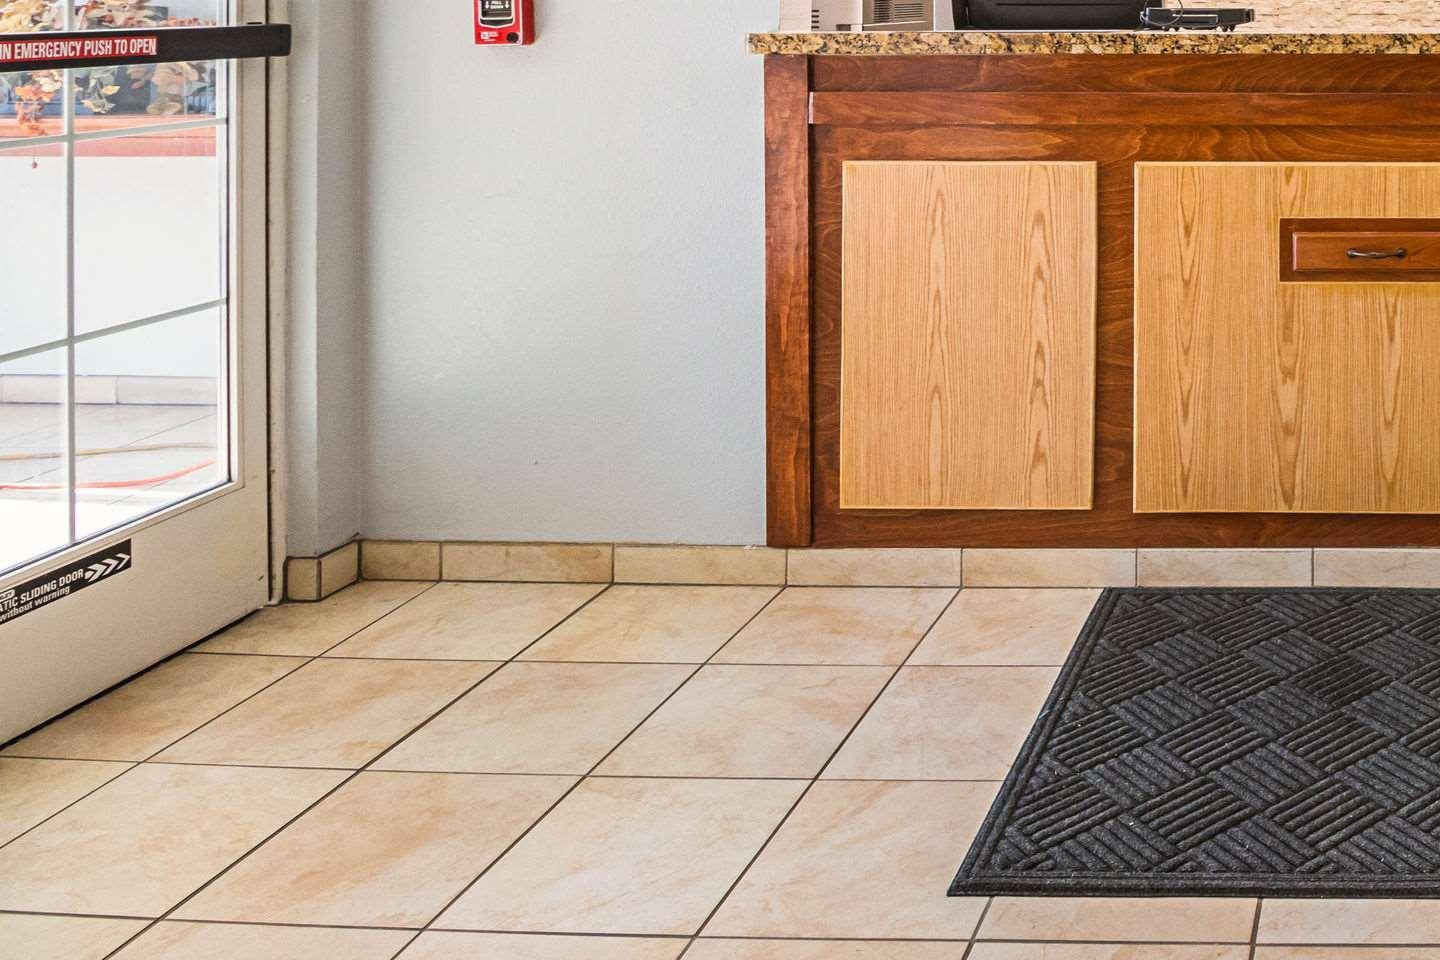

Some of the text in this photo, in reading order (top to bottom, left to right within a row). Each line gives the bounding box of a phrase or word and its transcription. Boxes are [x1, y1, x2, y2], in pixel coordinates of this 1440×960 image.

[14, 41, 82, 59] EMERGENCY
[84, 39, 113, 56] PUSH
[114, 39, 128, 55] TO
[129, 38, 158, 56] OPEN
[20, 580, 57, 604] SLIDING
[59, 569, 83, 586] DOOR
[34, 586, 70, 606] warning
